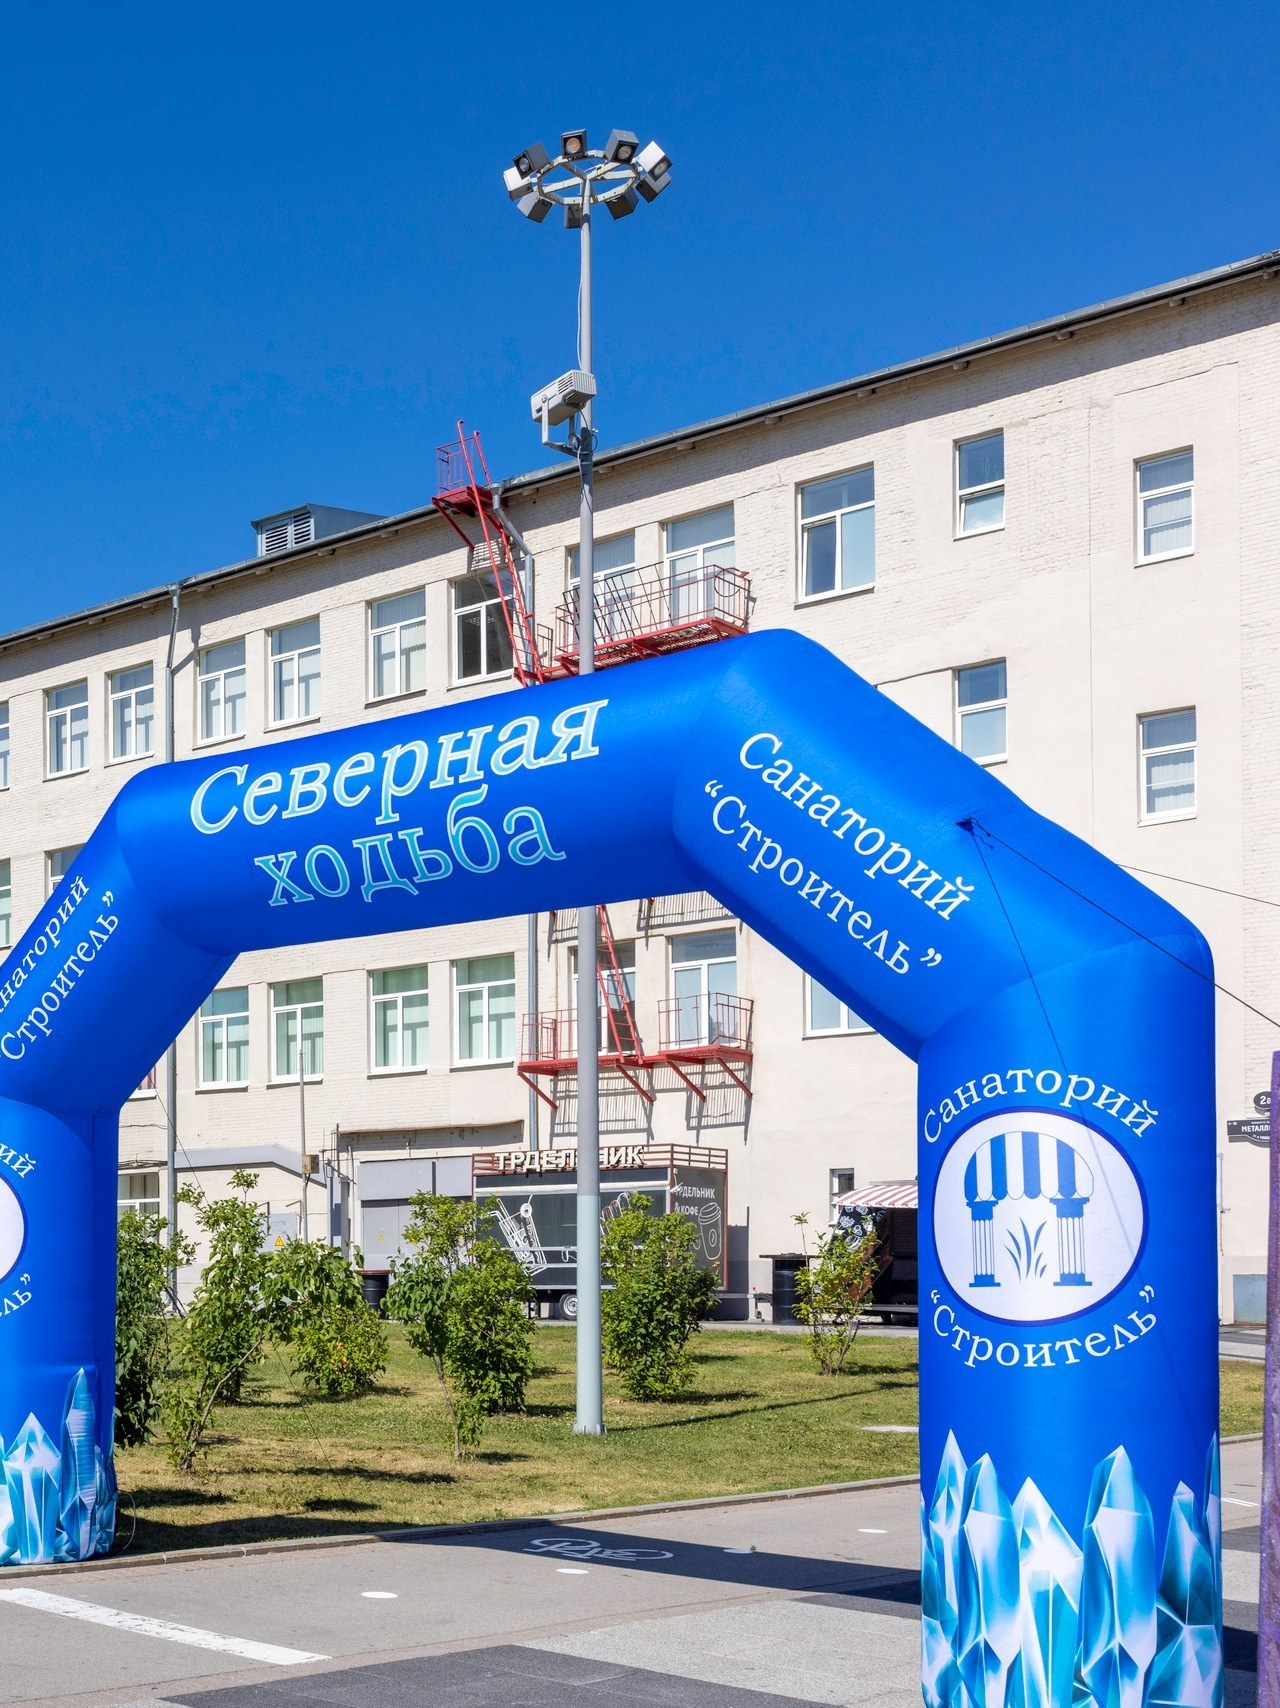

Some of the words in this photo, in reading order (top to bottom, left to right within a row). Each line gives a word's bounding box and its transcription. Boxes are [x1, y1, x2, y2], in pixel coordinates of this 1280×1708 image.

[189, 698, 610, 835] Северная
[254, 783, 568, 907] ходьба
[704, 779, 943, 975] “Строитель”
[739, 732, 975, 921] Санаторий
[923, 1068, 1159, 1144] Санаторий
[1241, 1125, 1271, 1133] МЕТАЛЛ
[494, 1145, 645, 1173] ТРДЕЛНИК
[930, 1284, 1158, 1368] “Строитель”
